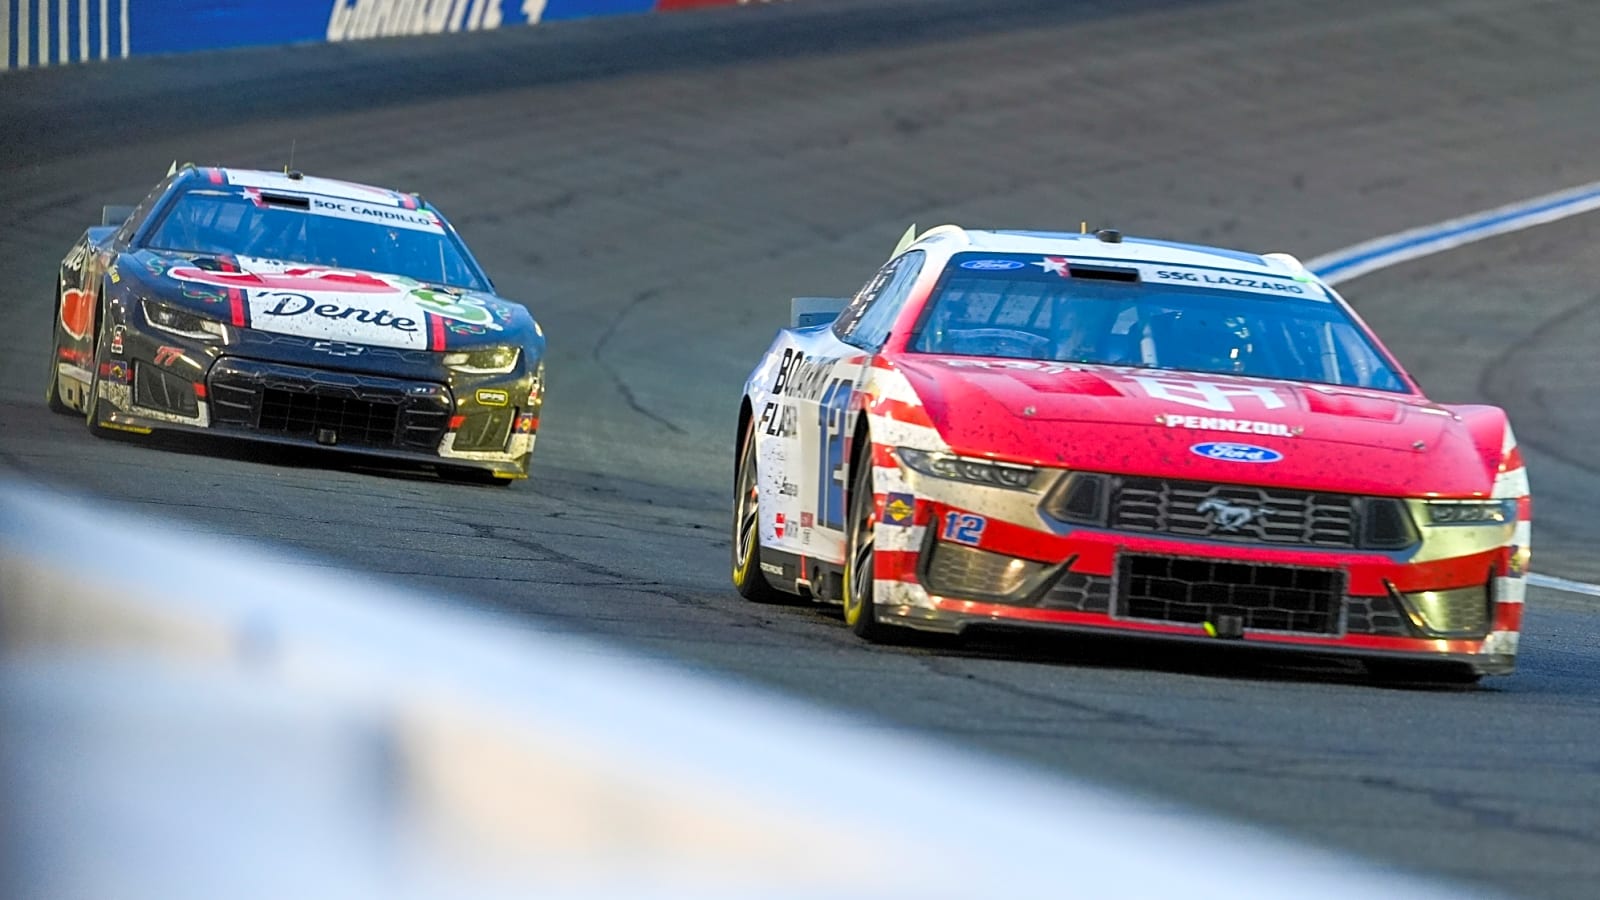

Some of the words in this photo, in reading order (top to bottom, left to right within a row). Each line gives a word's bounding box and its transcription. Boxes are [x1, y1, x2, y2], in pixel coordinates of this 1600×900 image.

[314, 199, 346, 212] SOC
[351, 206, 431, 226] CARDILLO
[1156, 270, 1199, 283] SSG
[1203, 274, 1304, 294] LAZZARO
[154, 345, 186, 367] 77
[1165, 413, 1294, 438] PENNZOIL
[1208, 444, 1265, 460] Ford
[943, 510, 987, 546] 12
